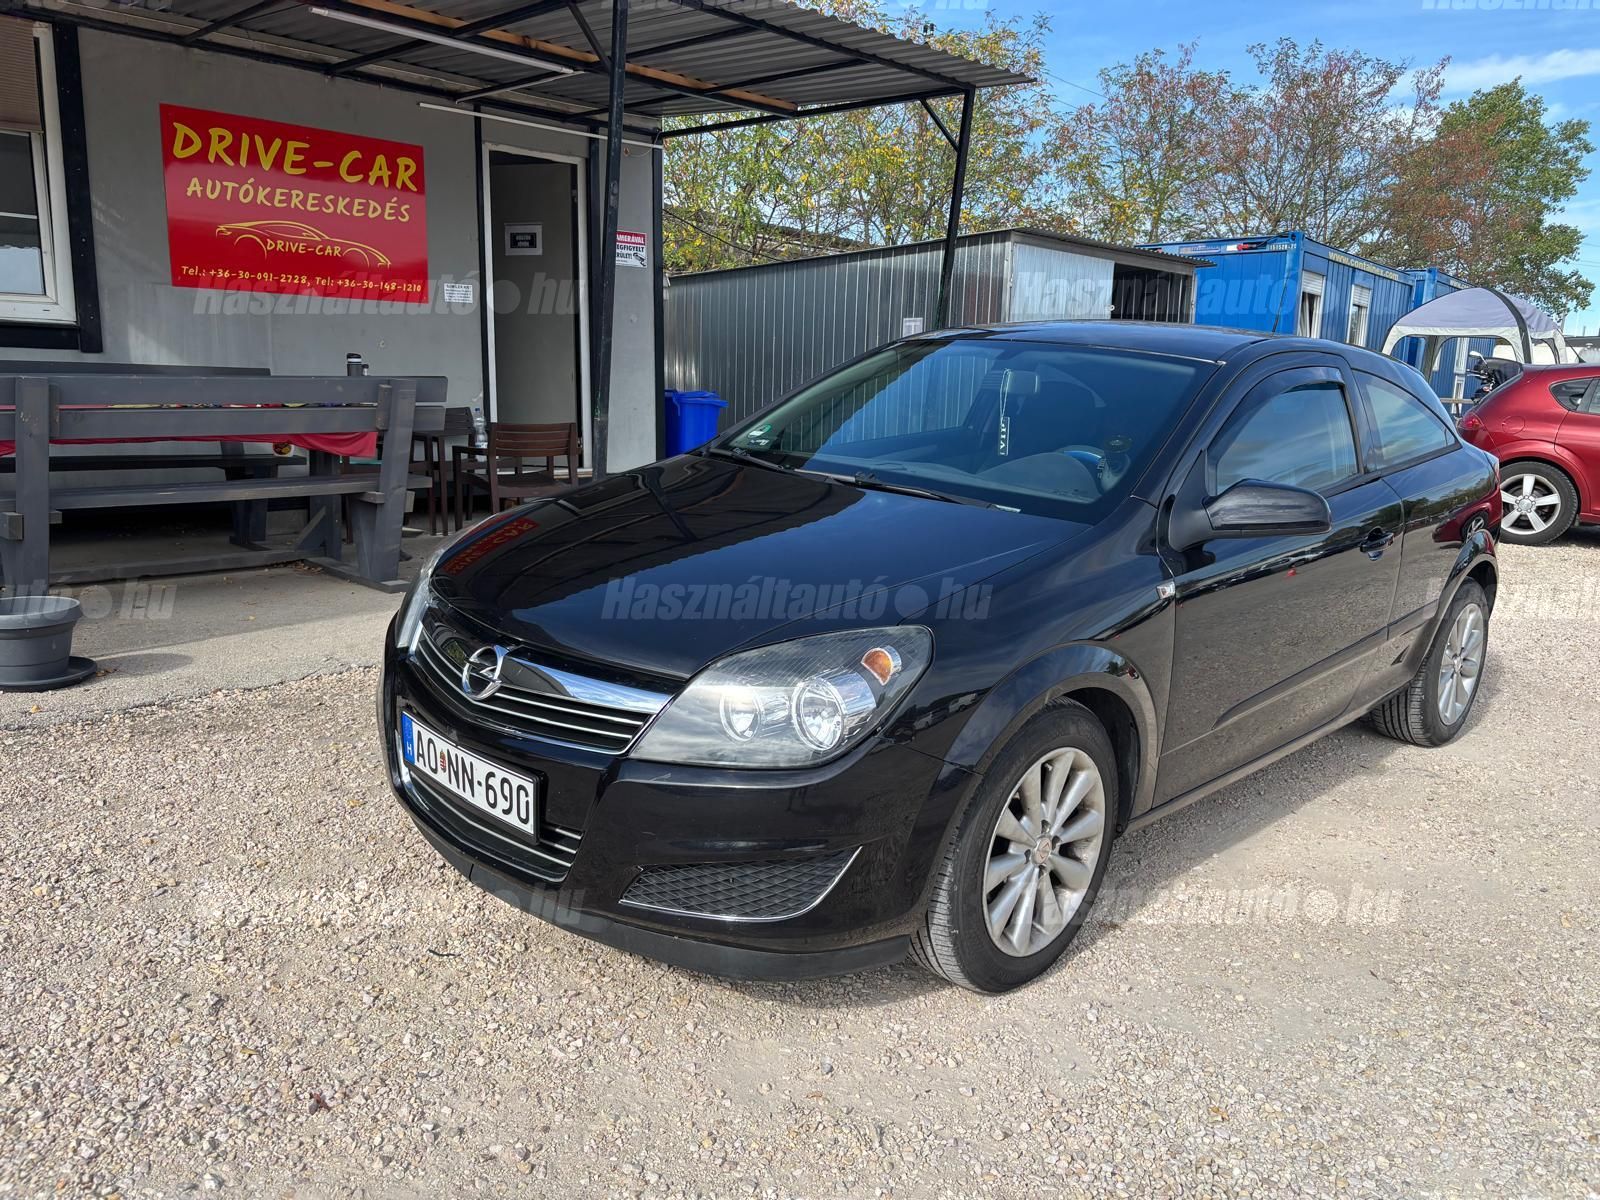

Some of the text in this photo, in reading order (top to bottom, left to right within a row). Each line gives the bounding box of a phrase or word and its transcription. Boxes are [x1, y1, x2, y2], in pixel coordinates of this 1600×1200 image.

[172, 122, 418, 192] DRIVE-CAR
[186, 177, 410, 222] AUTÓKERESKEDÉS
[266, 239, 342, 257] DRIVE-CAR
[182, 266, 206, 277] Tel.:
[209, 269, 311, 287] +36-30-091-2728,
[315, 276, 334, 286] Tel:
[416, 730, 530, 825] AO NN-690
